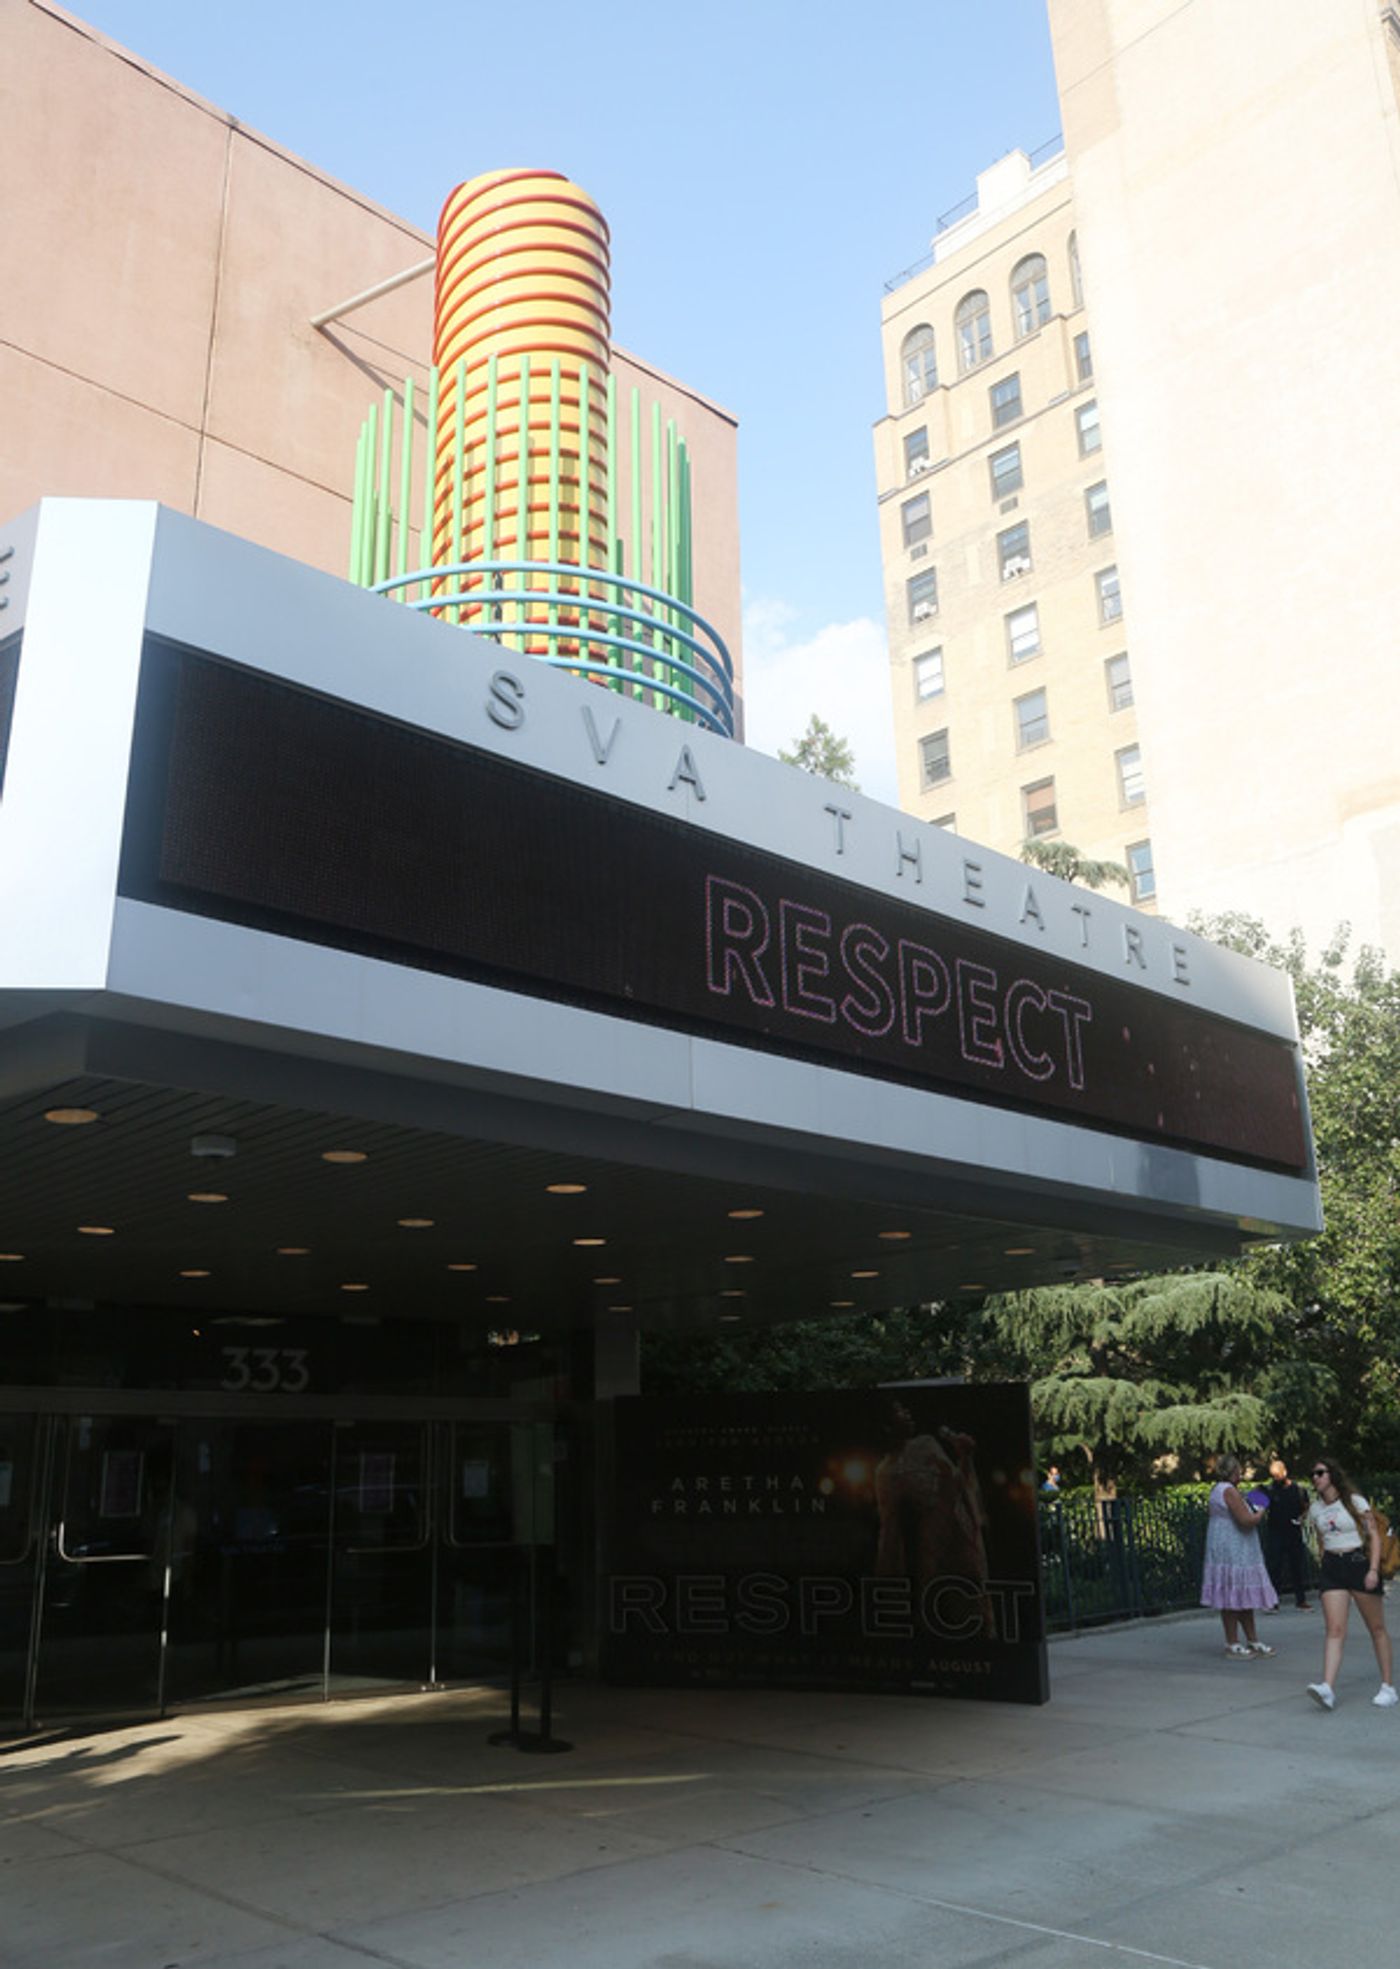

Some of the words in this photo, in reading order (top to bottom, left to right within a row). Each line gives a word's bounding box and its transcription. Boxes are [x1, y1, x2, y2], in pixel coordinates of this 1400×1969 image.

[485, 669, 707, 802] SVA
[823, 803, 1191, 986] THEATRE
[705, 874, 1092, 1090] RESPECT
[220, 1346, 310, 1392] 333
[651, 1498, 826, 1514] FRANKLIN
[671, 1475, 804, 1491] ARETHA
[609, 1572, 1036, 1643] RESPECT
[926, 1658, 992, 1676] AUGUST
